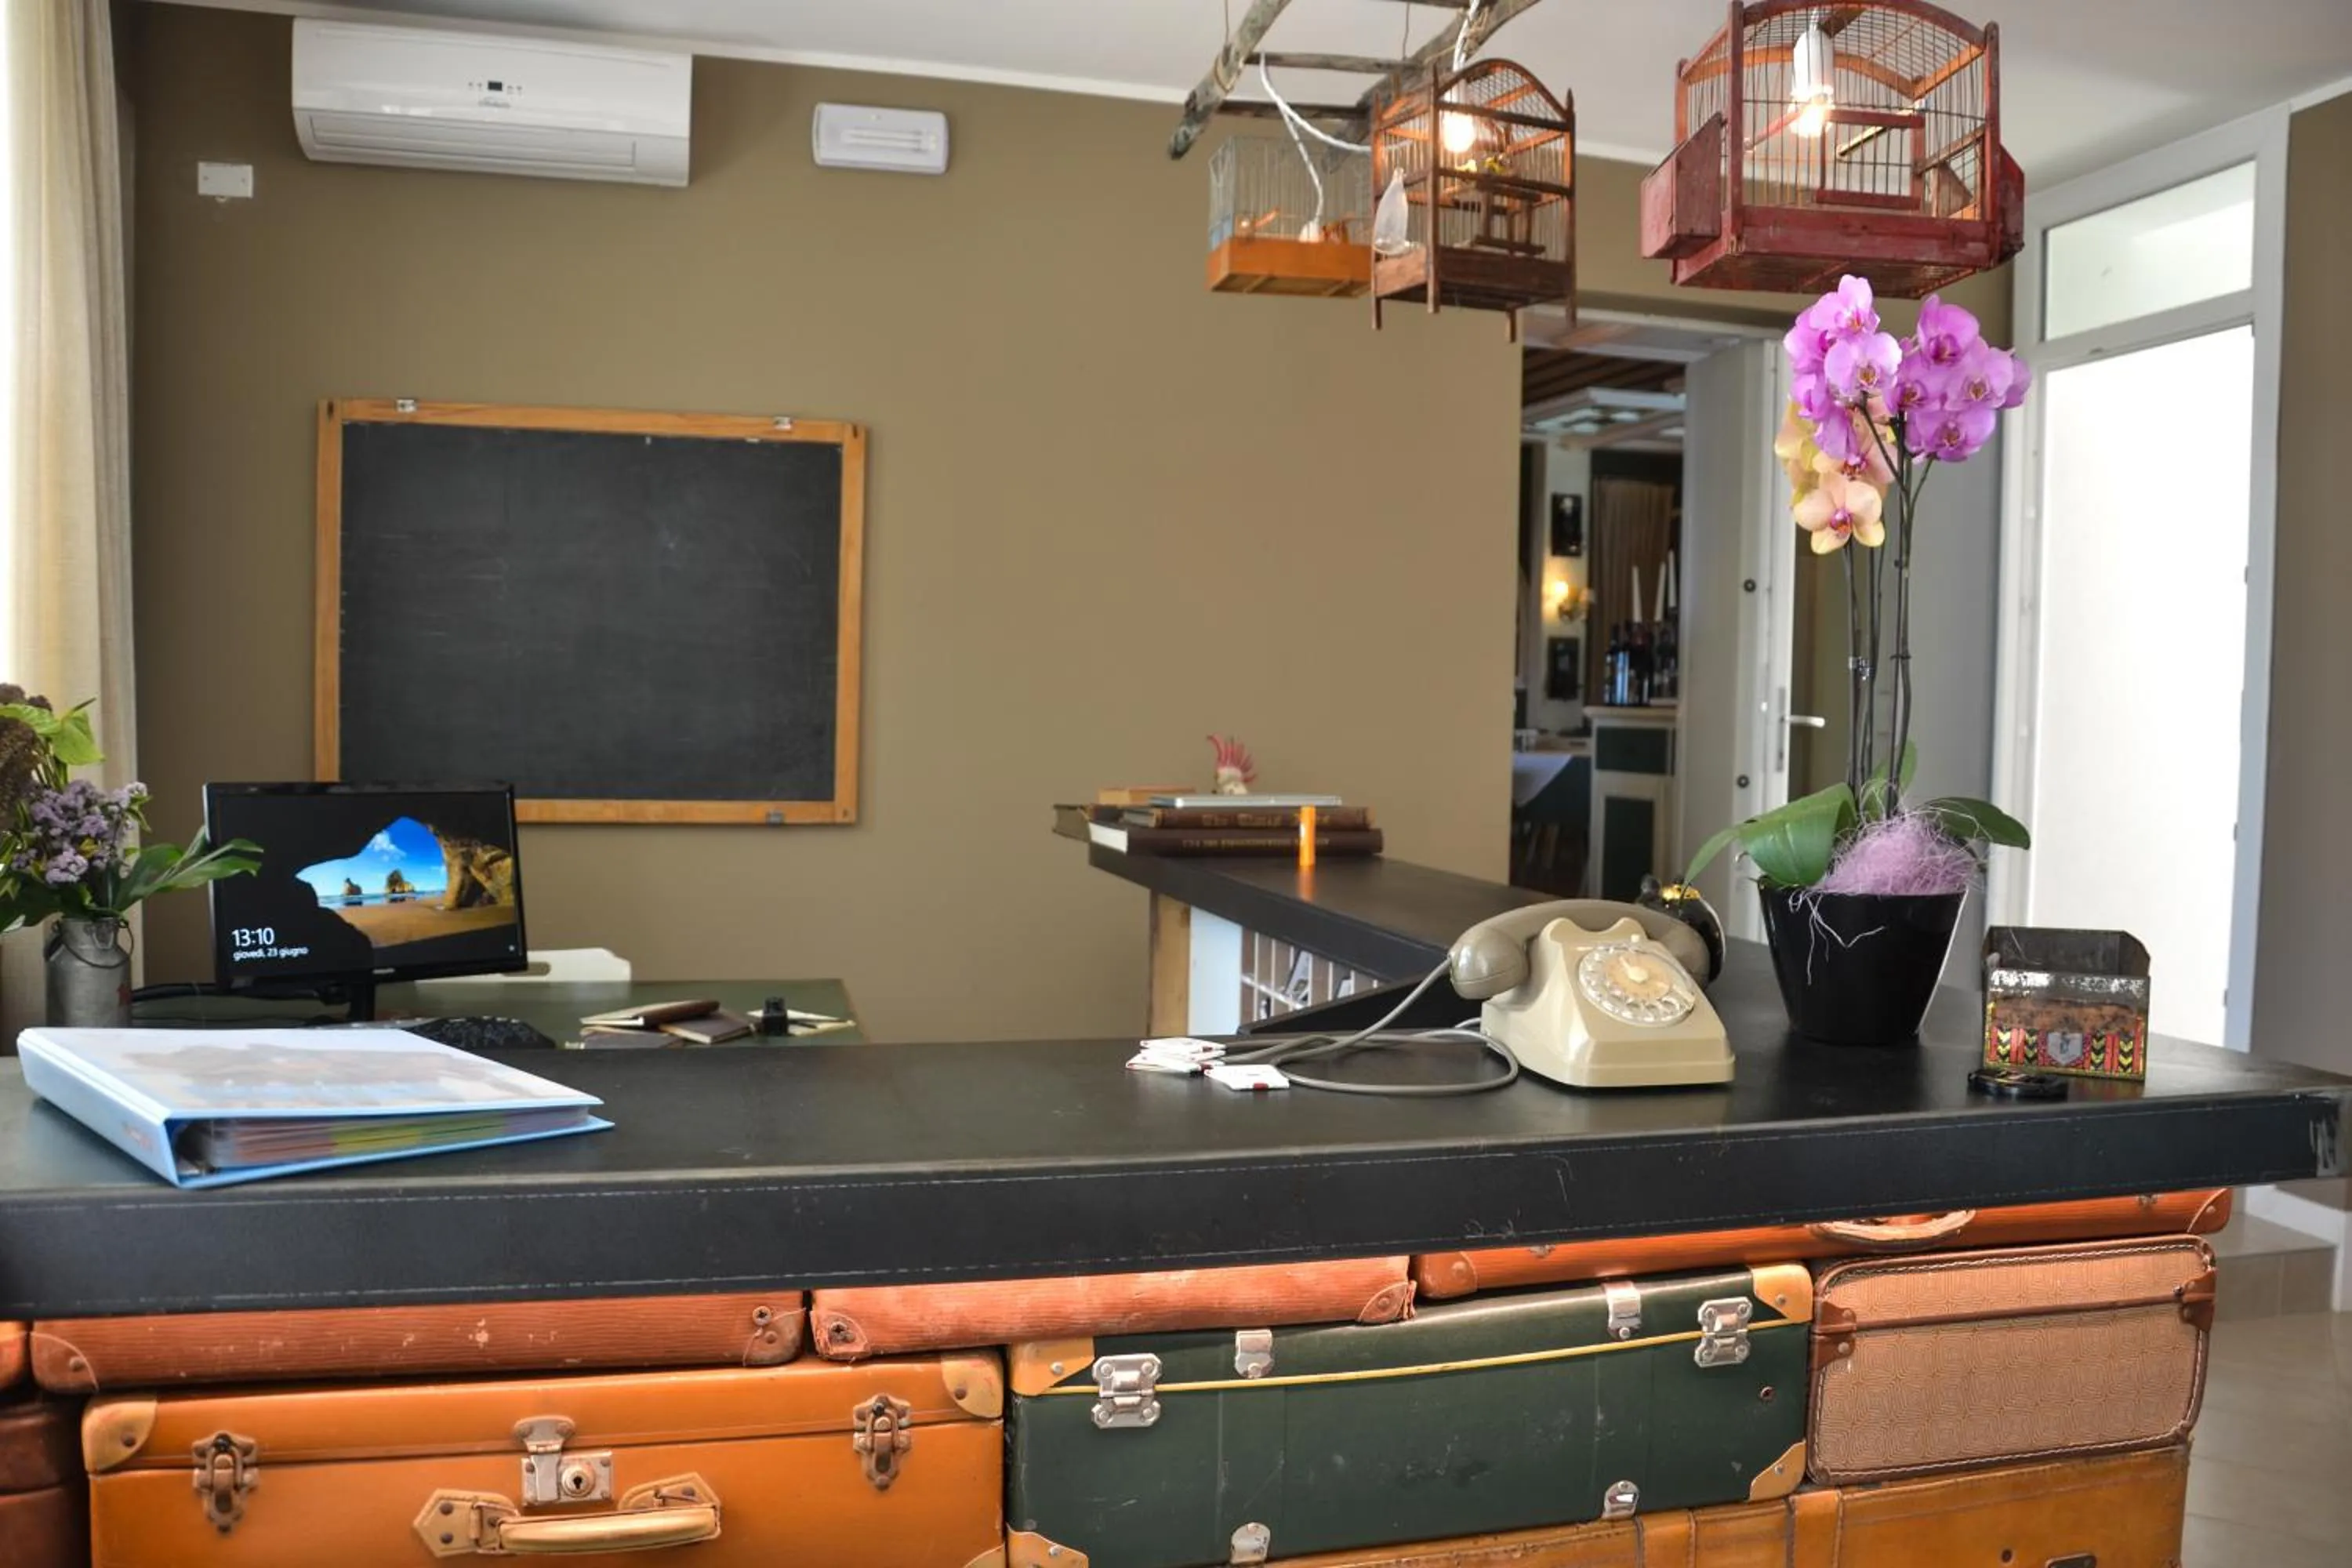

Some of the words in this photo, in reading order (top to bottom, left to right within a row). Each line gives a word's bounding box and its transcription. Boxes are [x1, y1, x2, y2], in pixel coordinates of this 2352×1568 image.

[232, 927, 275, 947] 13:10
[267, 947, 278, 957] 23
[279, 946, 309, 959] giugno
